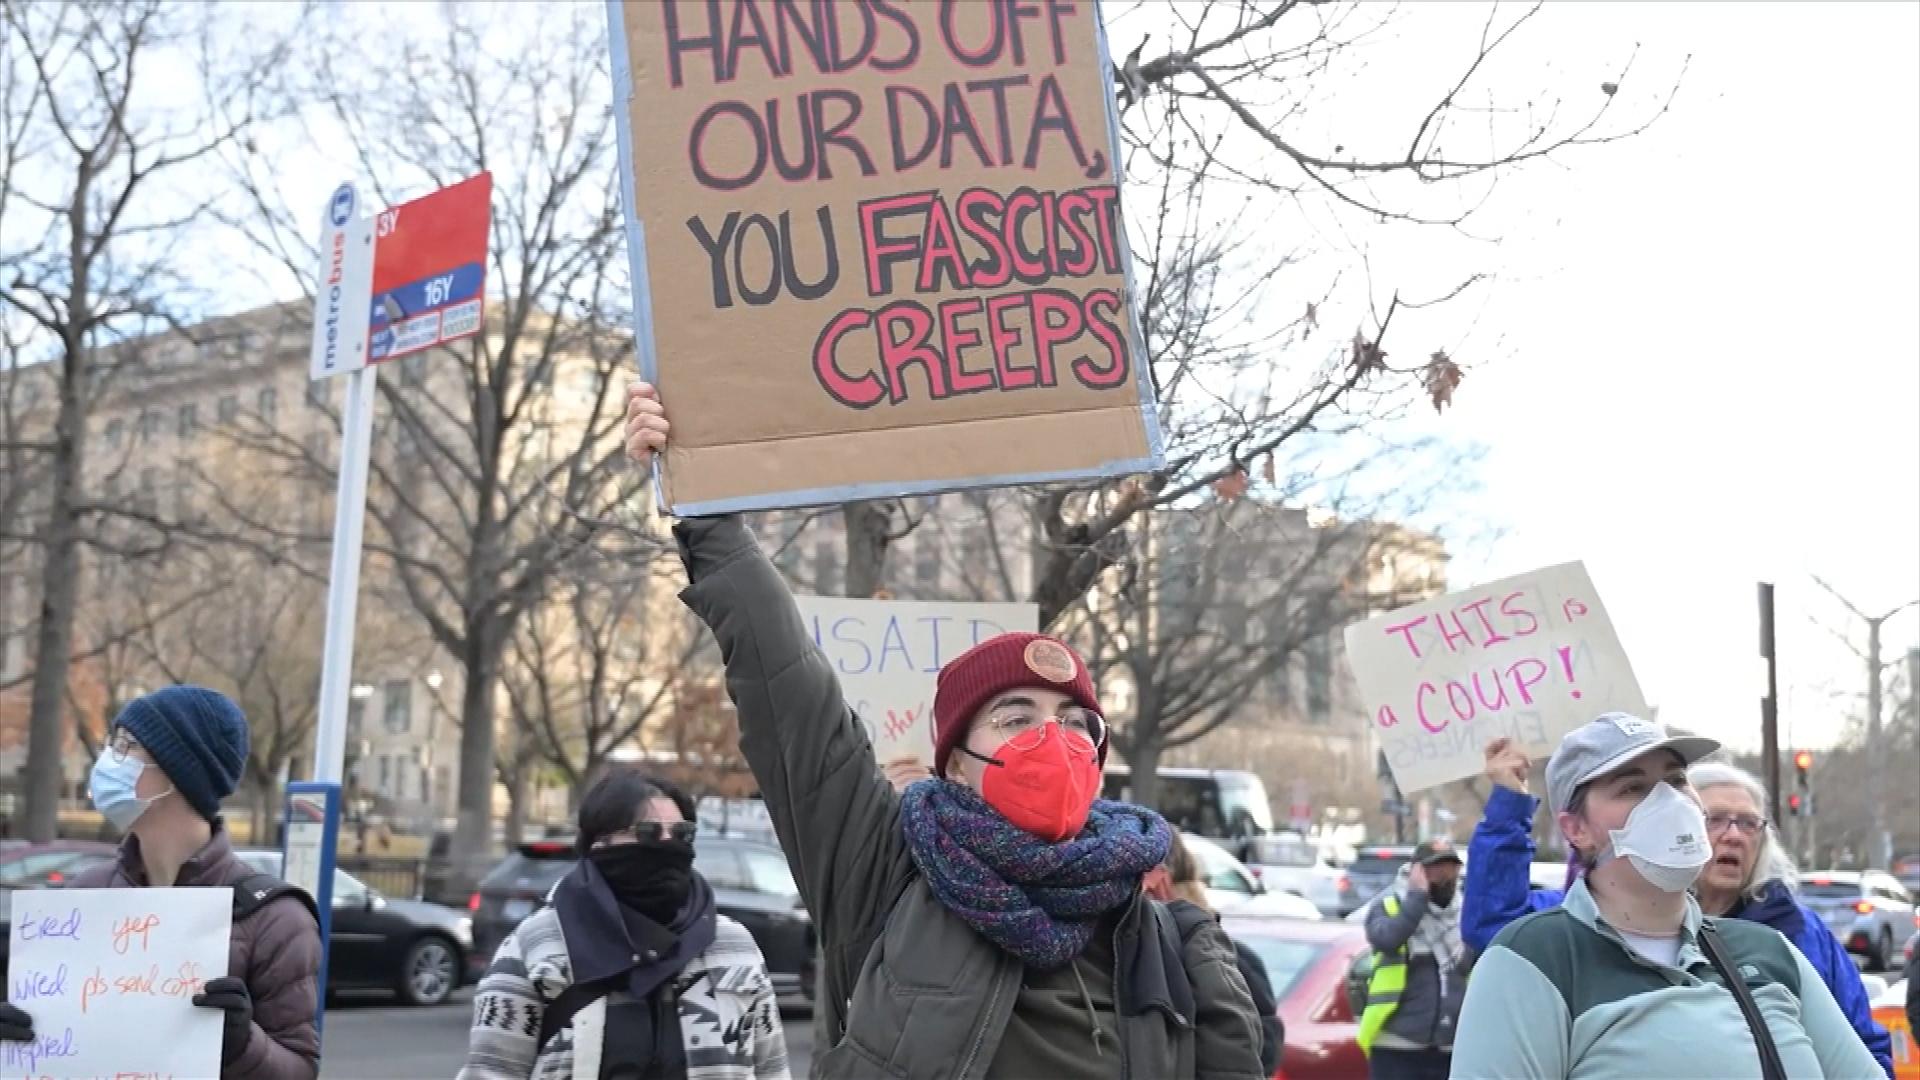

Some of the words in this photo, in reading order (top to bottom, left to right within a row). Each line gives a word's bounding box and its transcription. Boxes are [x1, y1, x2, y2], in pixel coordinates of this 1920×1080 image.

[660, 0, 921, 88] HANDS
[939, 0, 1077, 70] OFF
[687, 87, 878, 191] OUR
[884, 74, 1106, 180] DATA,
[378, 209, 401, 238] 3Y
[685, 205, 840, 309] YOU
[857, 185, 1122, 297] FASCIST
[324, 231, 346, 369] metrobus
[424, 273, 454, 306] 16Y
[812, 287, 1129, 411] CREEPS
[1385, 592, 1539, 659] THIS
[1377, 705, 1400, 729] a
[1415, 645, 1582, 735] COUP!
[112, 913, 161, 955] yep
